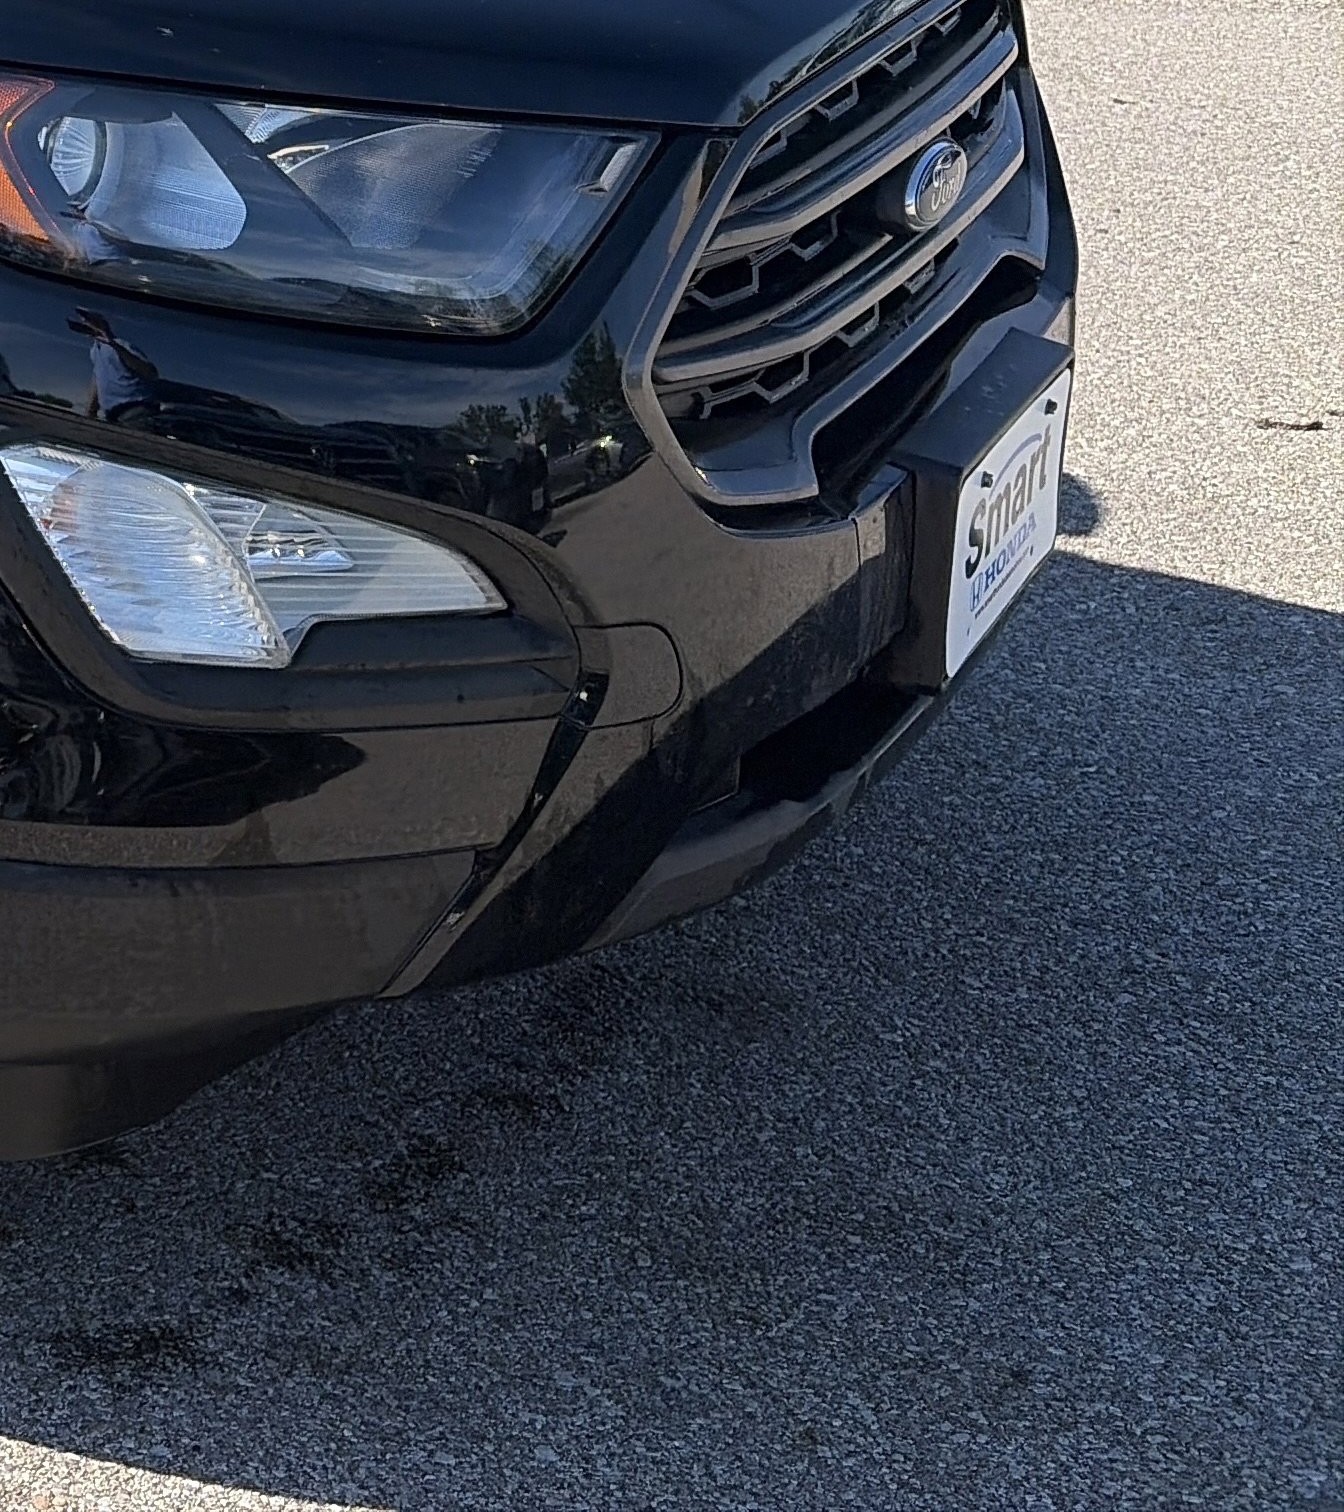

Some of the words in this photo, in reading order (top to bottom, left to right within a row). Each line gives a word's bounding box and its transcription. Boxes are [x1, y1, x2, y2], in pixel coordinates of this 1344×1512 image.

[931, 152, 962, 212] Ford
[964, 424, 1052, 580] Smart
[983, 512, 1037, 592] HONDA
